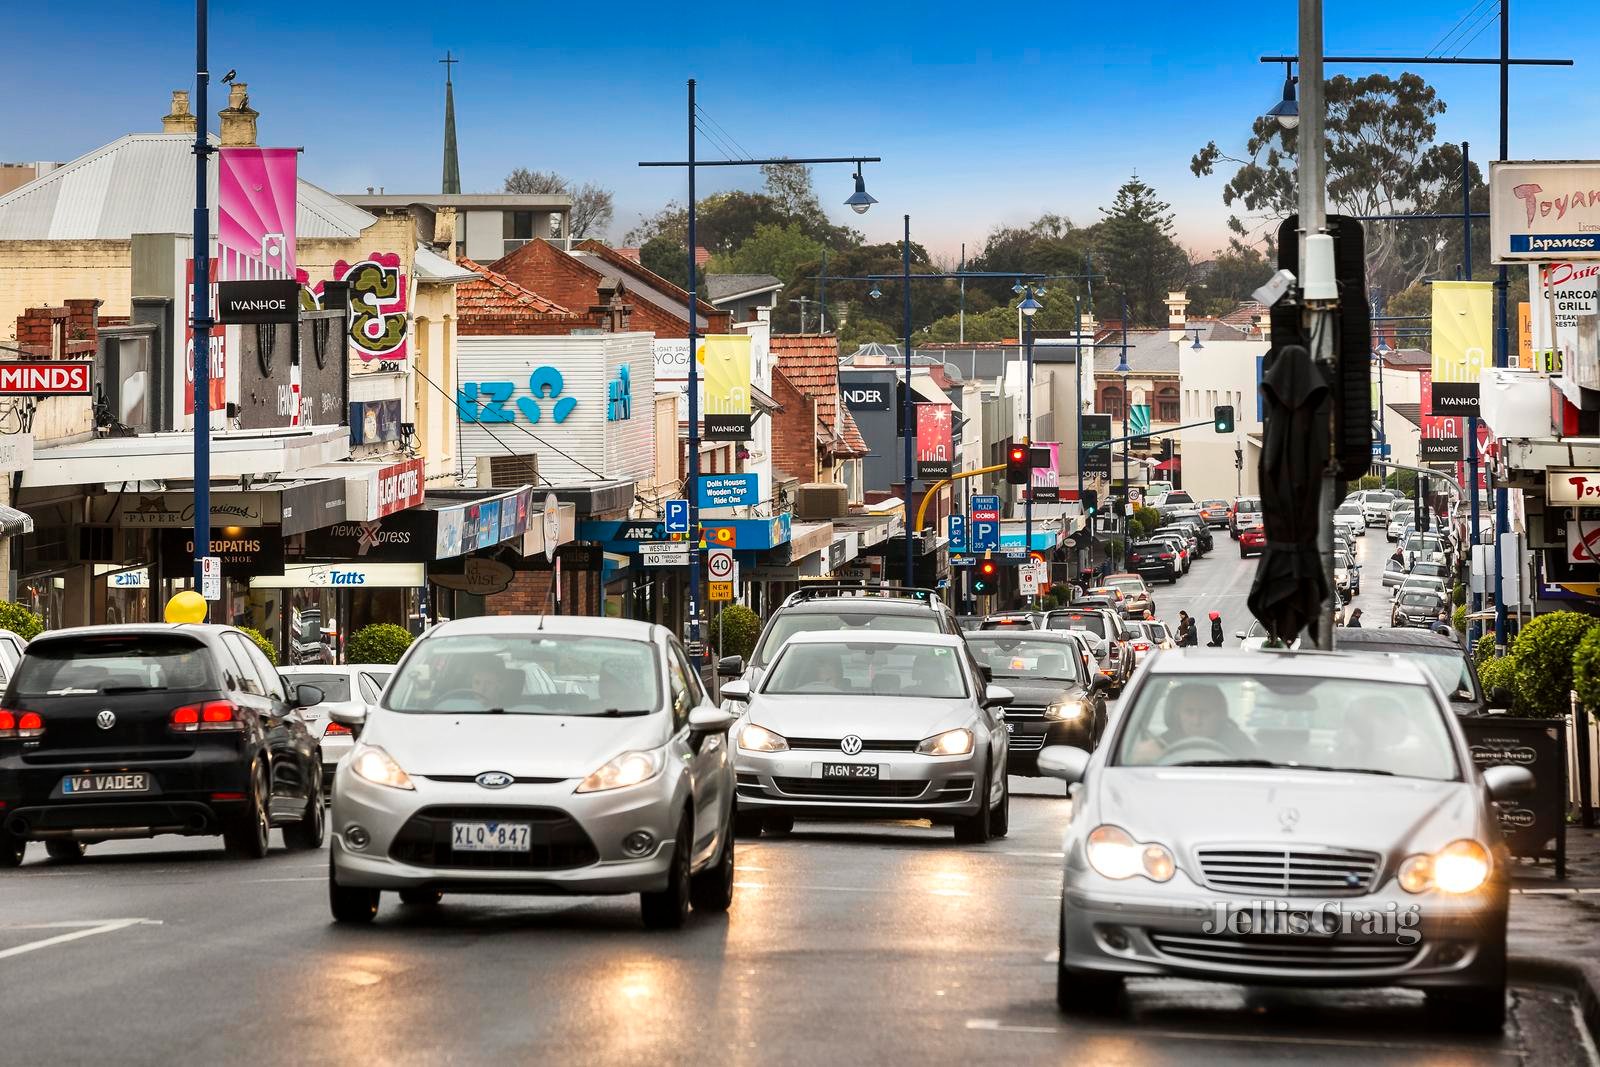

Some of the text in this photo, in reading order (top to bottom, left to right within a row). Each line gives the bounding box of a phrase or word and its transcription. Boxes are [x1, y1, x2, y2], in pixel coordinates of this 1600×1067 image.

[1528, 236, 1595, 251] Japanese
[230, 299, 286, 311] IVANHOE
[1558, 302, 1591, 311] GRILL
[1, 369, 83, 389] MINDS
[843, 390, 882, 403] NDER
[1440, 397, 1480, 405] IVANHO
[711, 425, 744, 433] IVANHOE
[1427, 445, 1458, 453] IVANHOE
[380, 469, 418, 506] FLIGHT CENTRE
[706, 478, 746, 487] Dolls Houses
[706, 487, 747, 496] Wooden Toys
[713, 496, 741, 505] Ride Ons
[128, 503, 257, 522] PAPER Oasions
[671, 505, 682, 518] P
[975, 512, 996, 520] coles
[951, 516, 962, 529] P
[624, 528, 653, 539] ANZ
[979, 524, 992, 540] P
[186, 540, 260, 554] OEOPATHS
[648, 556, 660, 564] NO
[713, 559, 729, 570] 40
[329, 571, 366, 585] Tatts
[96, 775, 143, 791] VADER
[455, 826, 529, 844] XLQ 847
